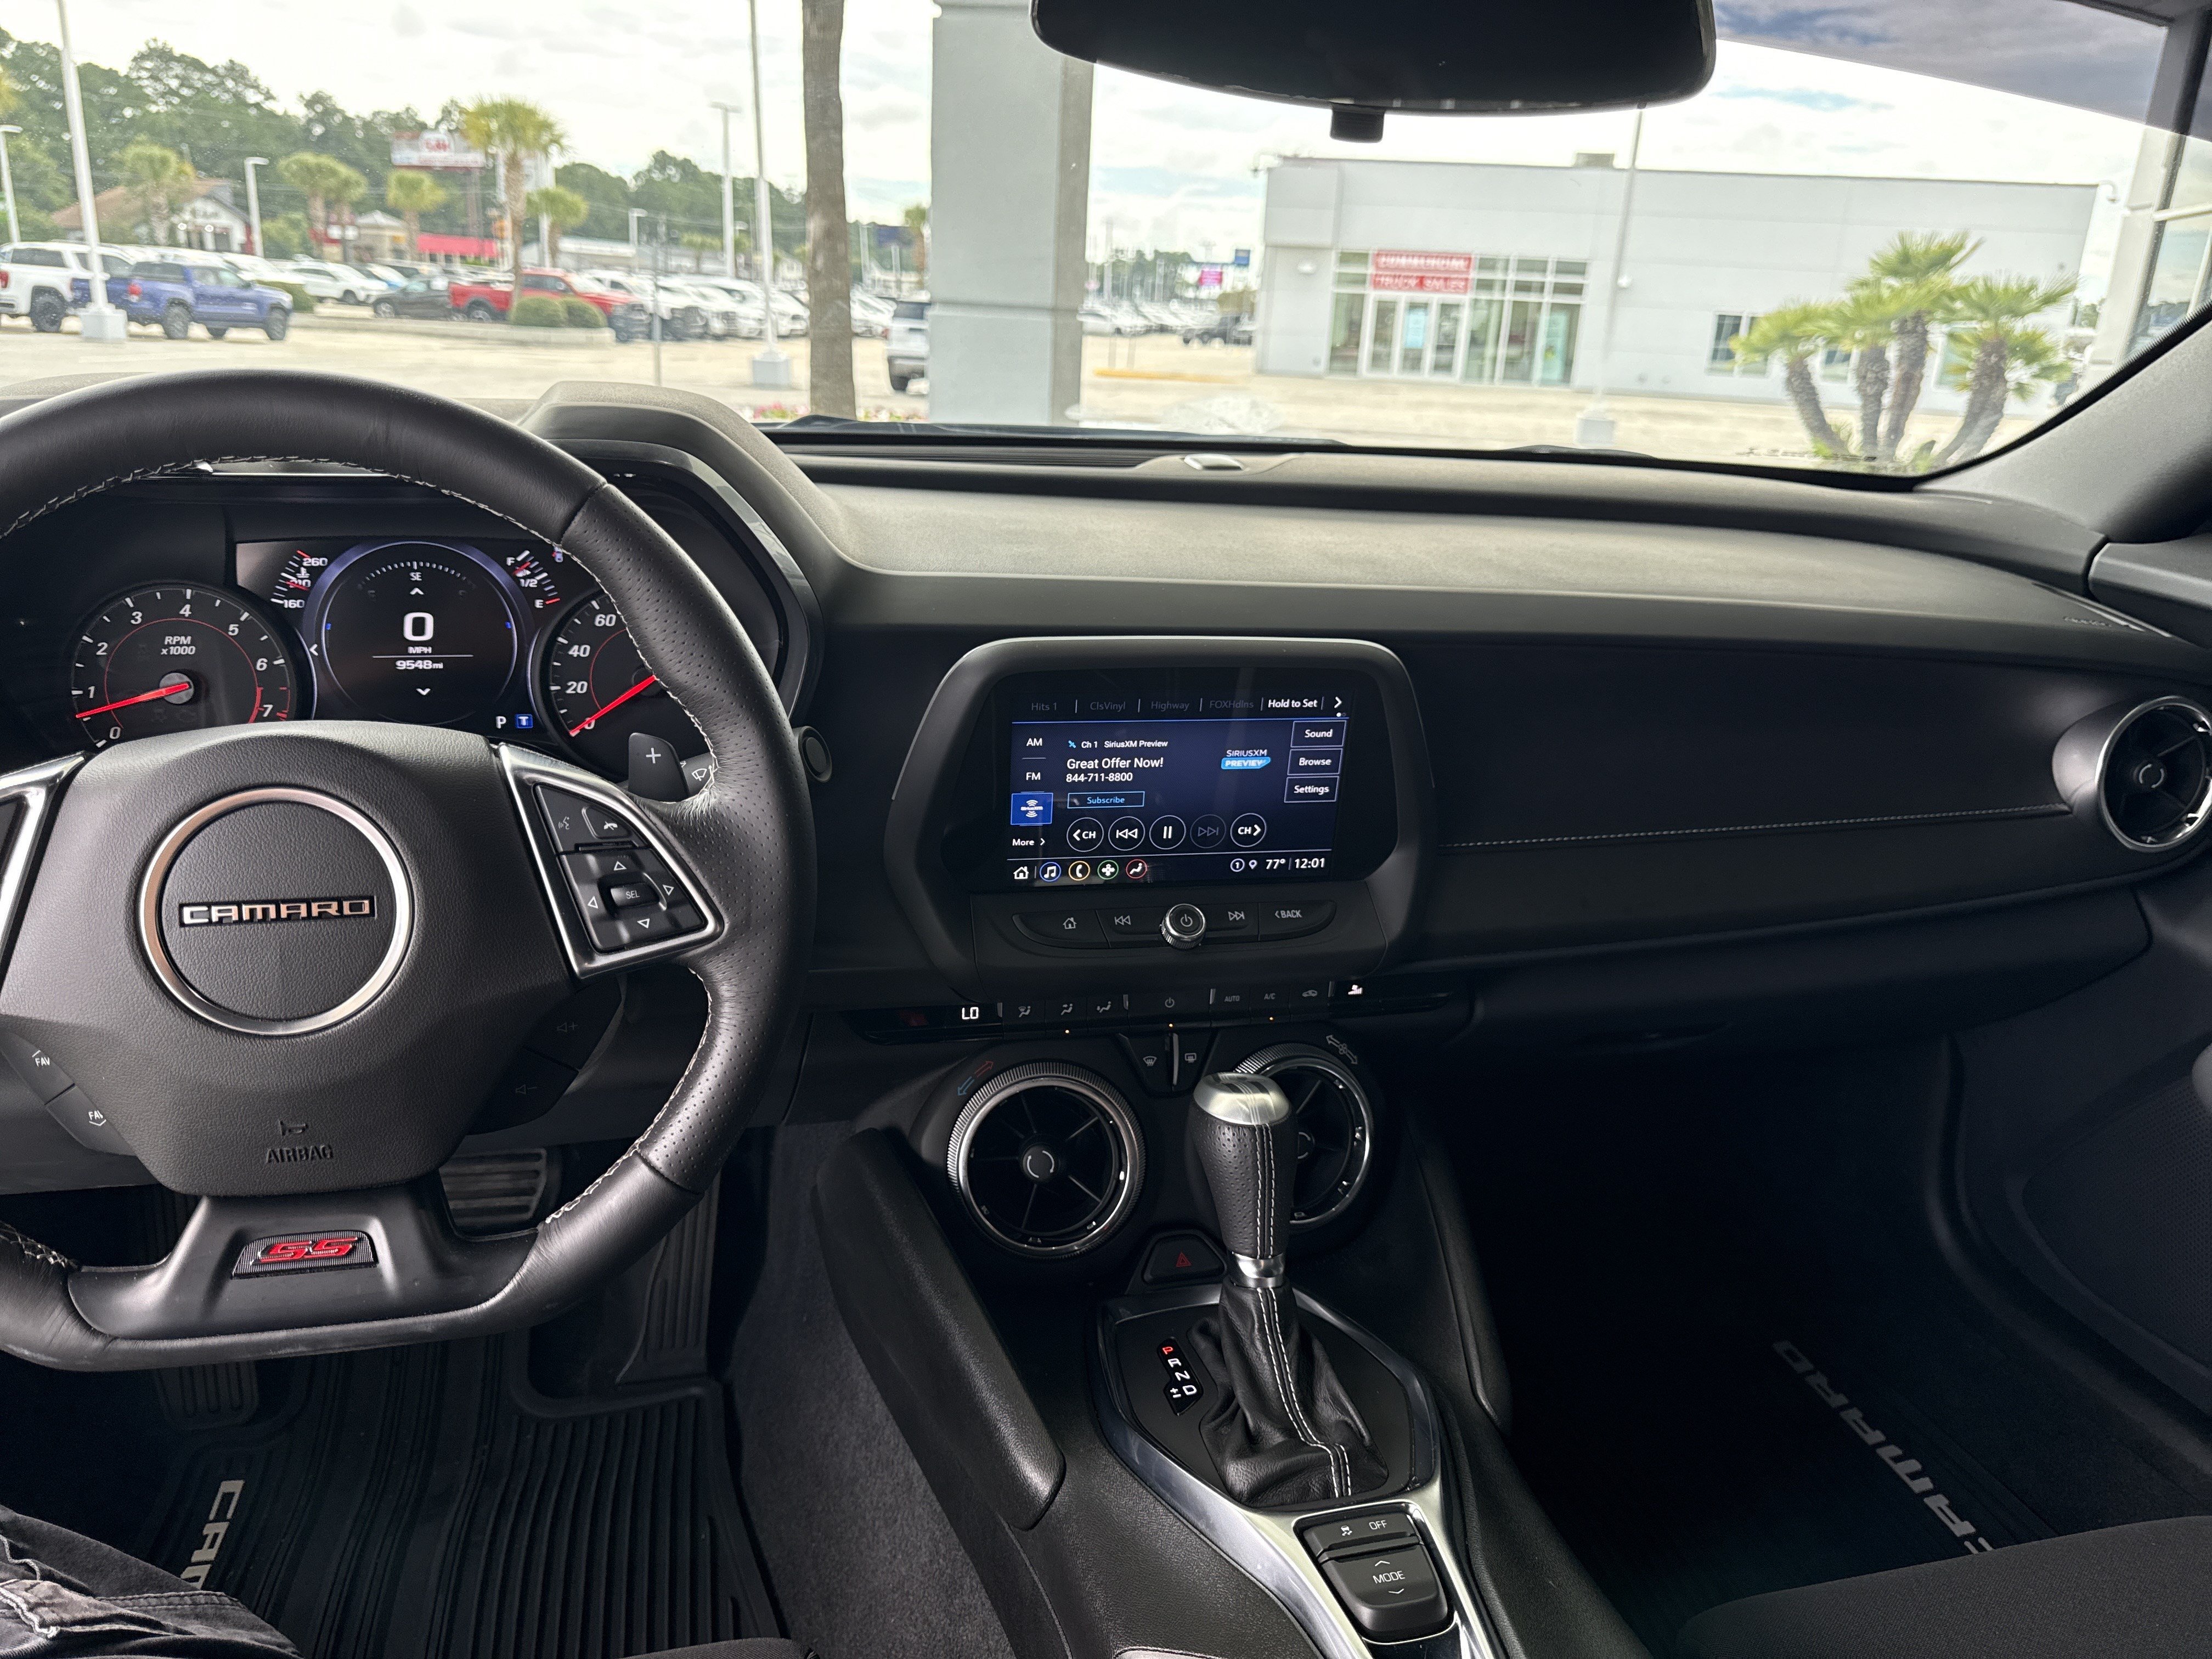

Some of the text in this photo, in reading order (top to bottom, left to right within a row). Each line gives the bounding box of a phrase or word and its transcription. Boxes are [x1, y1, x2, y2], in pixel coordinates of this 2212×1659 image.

[302, 557, 328, 566] 260
[506, 557, 515, 566] F
[409, 572, 422, 581] SE
[520, 578, 538, 588] 1/2
[283, 599, 305, 608] 160
[534, 599, 544, 608] E
[179, 604, 192, 617] 4
[131, 611, 143, 624] 3
[594, 614, 616, 627] 60
[228, 624, 239, 636] 5
[403, 612, 434, 641] 0
[164, 636, 191, 645] RPM
[96, 642, 108, 655] 2
[161, 646, 196, 655] x1000
[567, 645, 591, 657] 40
[256, 658, 268, 671] 6
[88, 686, 95, 698] 1
[565, 681, 588, 693] 20
[1031, 702, 1057, 711] Hits 1
[1090, 702, 1126, 712] ClsVinyl
[1151, 701, 1189, 712] Highway
[1268, 699, 1289, 708] Hold
[1303, 699, 1318, 708] Set
[263, 704, 273, 717] 7
[495, 715, 506, 729] P
[109, 726, 121, 740] 0
[1305, 729, 1333, 738] Sound
[1026, 738, 1042, 747] AM
[1066, 757, 1164, 769] Great Offer Now!
[1225, 759, 1263, 768] PREVIEW
[1299, 758, 1332, 766] Browse
[1026, 772, 1041, 781] FM
[1066, 772, 1133, 782] 844-711-8800
[1294, 785, 1330, 795] Settings
[1087, 797, 1125, 805] Subscribe
[1082, 831, 1096, 839] CH
[1238, 826, 1252, 834] CH
[1266, 858, 1286, 870] 77°
[1295, 857, 1325, 869] 12:01
[625, 890, 640, 900] SEL
[183, 899, 370, 924] CAMARO
[1280, 910, 1302, 918] BACK
[962, 1007, 979, 1020] LO
[35, 1057, 50, 1067] FAV
[266, 1144, 334, 1164] AIRBAG
[259, 1237, 358, 1264] SS
[1162, 1346, 1173, 1355] P
[1167, 1358, 1182, 1368] R
[1175, 1370, 1190, 1381] N
[1182, 1385, 1197, 1395] D
[1369, 1520, 1387, 1530] OFF
[1373, 1570, 1406, 1584] MODE
